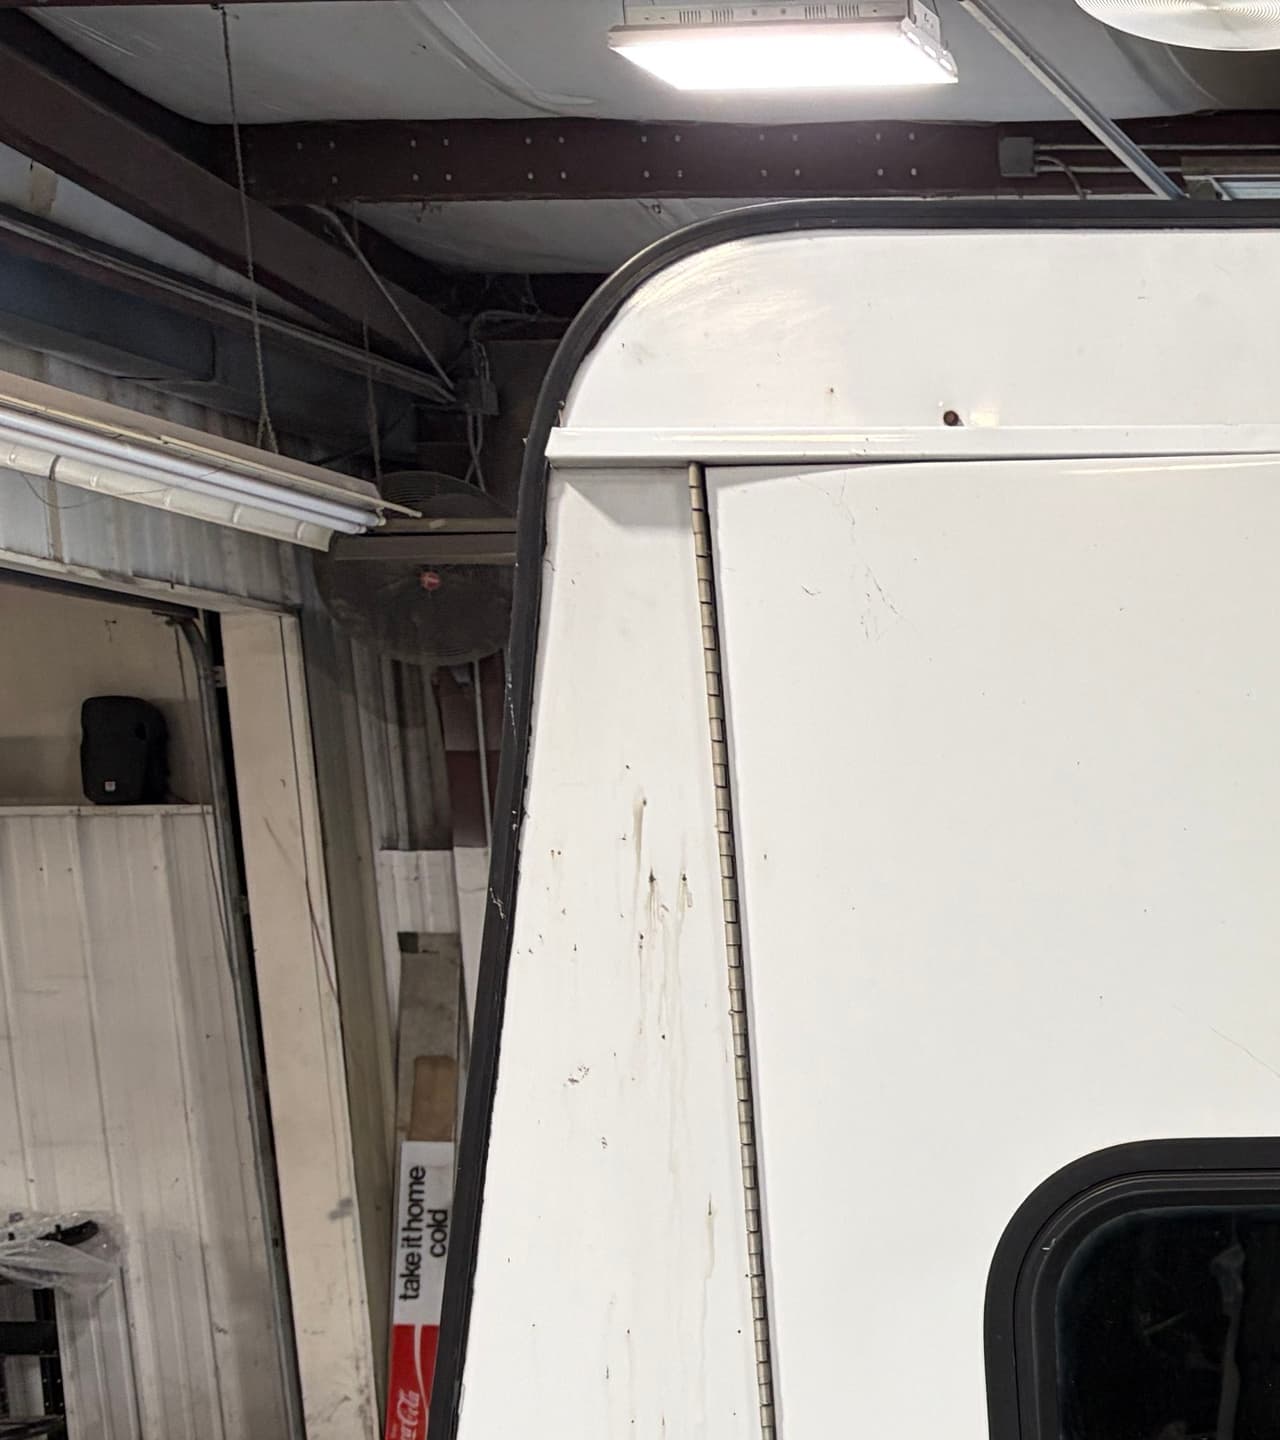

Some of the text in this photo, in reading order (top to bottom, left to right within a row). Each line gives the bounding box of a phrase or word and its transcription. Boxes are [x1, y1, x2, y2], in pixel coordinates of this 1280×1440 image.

[399, 1165, 426, 1301] take it home
[426, 1208, 448, 1258] cold
